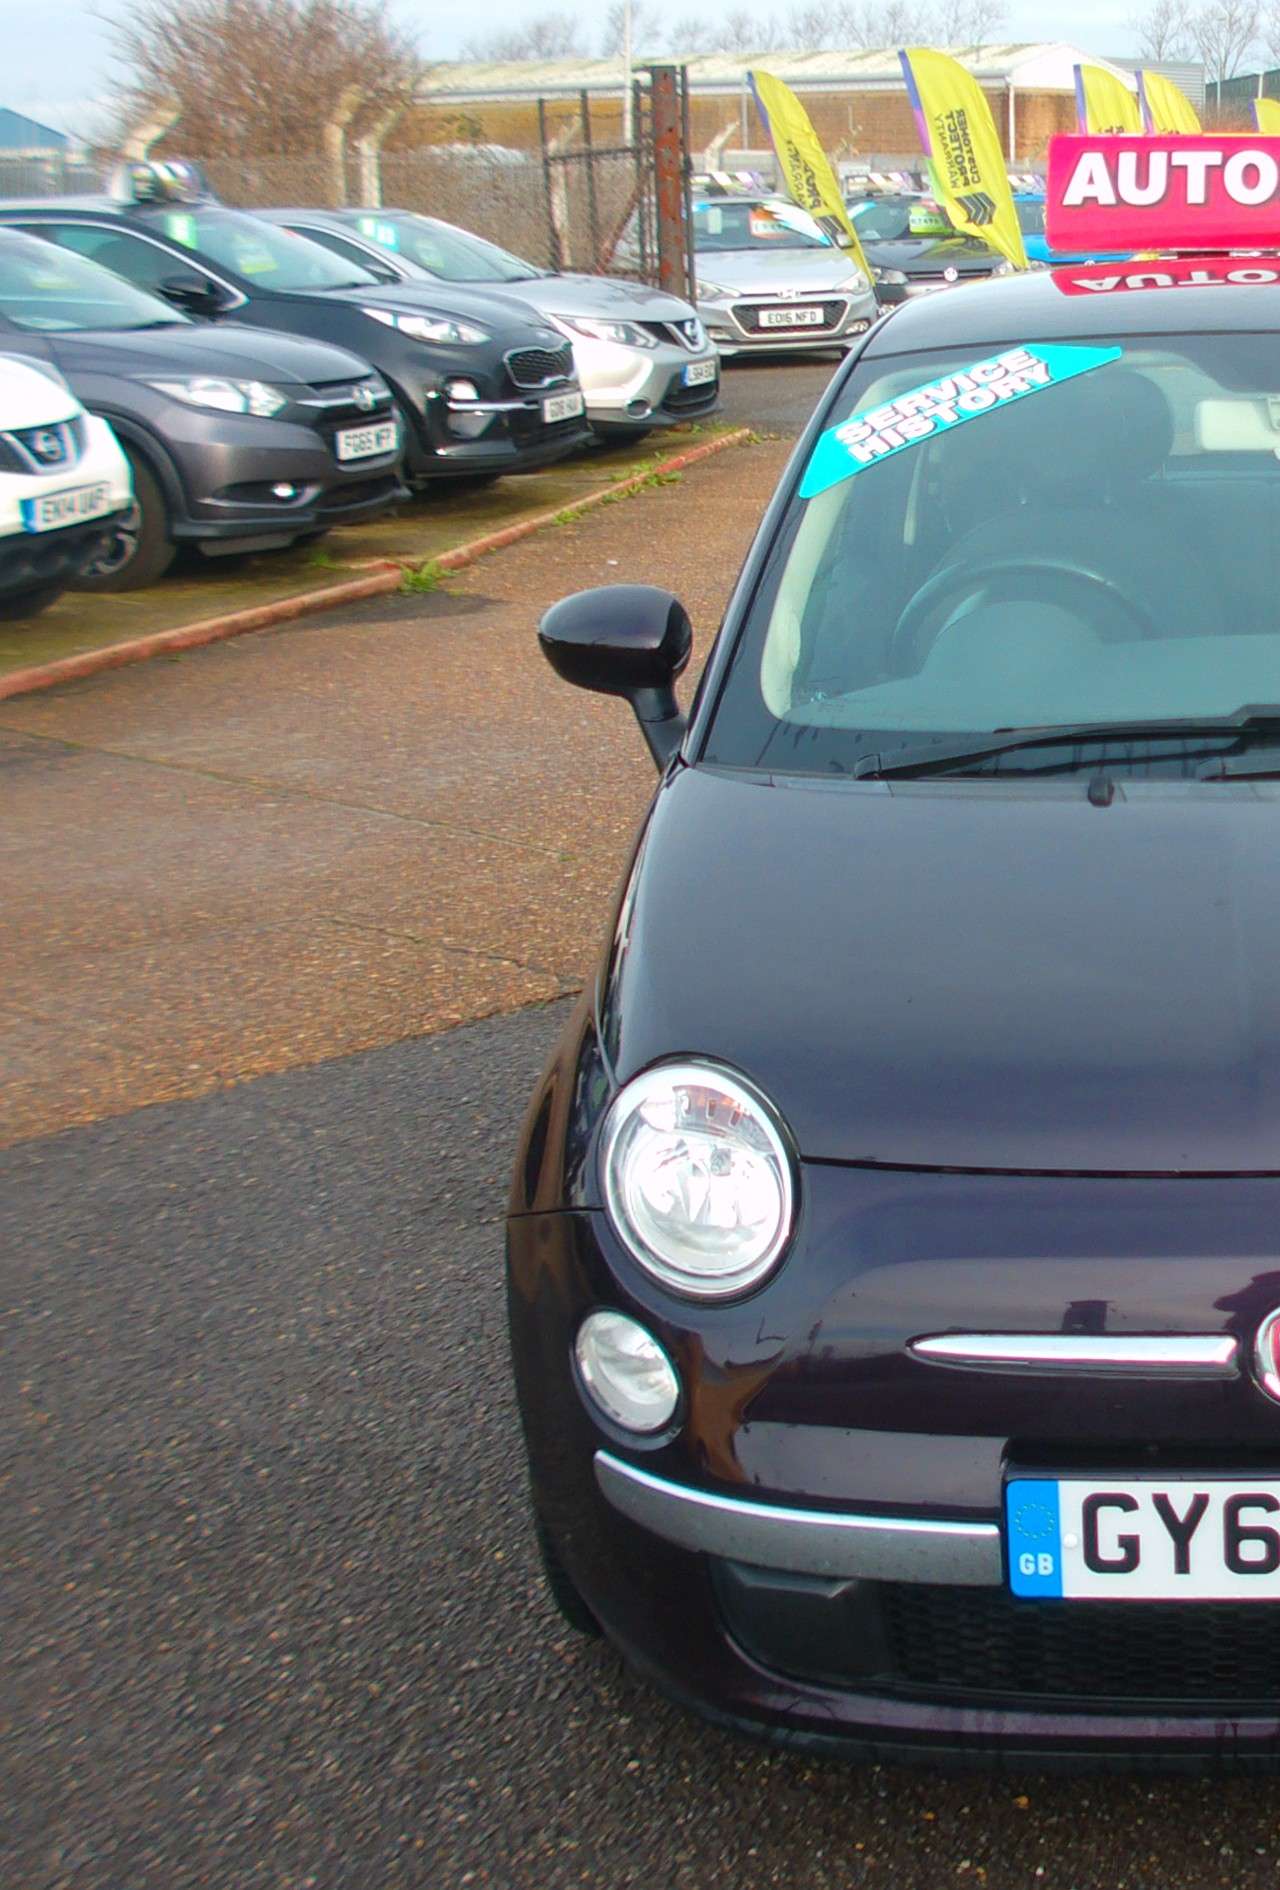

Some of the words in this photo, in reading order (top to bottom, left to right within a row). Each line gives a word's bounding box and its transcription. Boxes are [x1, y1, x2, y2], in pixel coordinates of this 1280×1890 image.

[835, 349, 1041, 445] SERVICE
[847, 362, 1054, 464] HISTORY
[1017, 1552, 1054, 1577] GB
